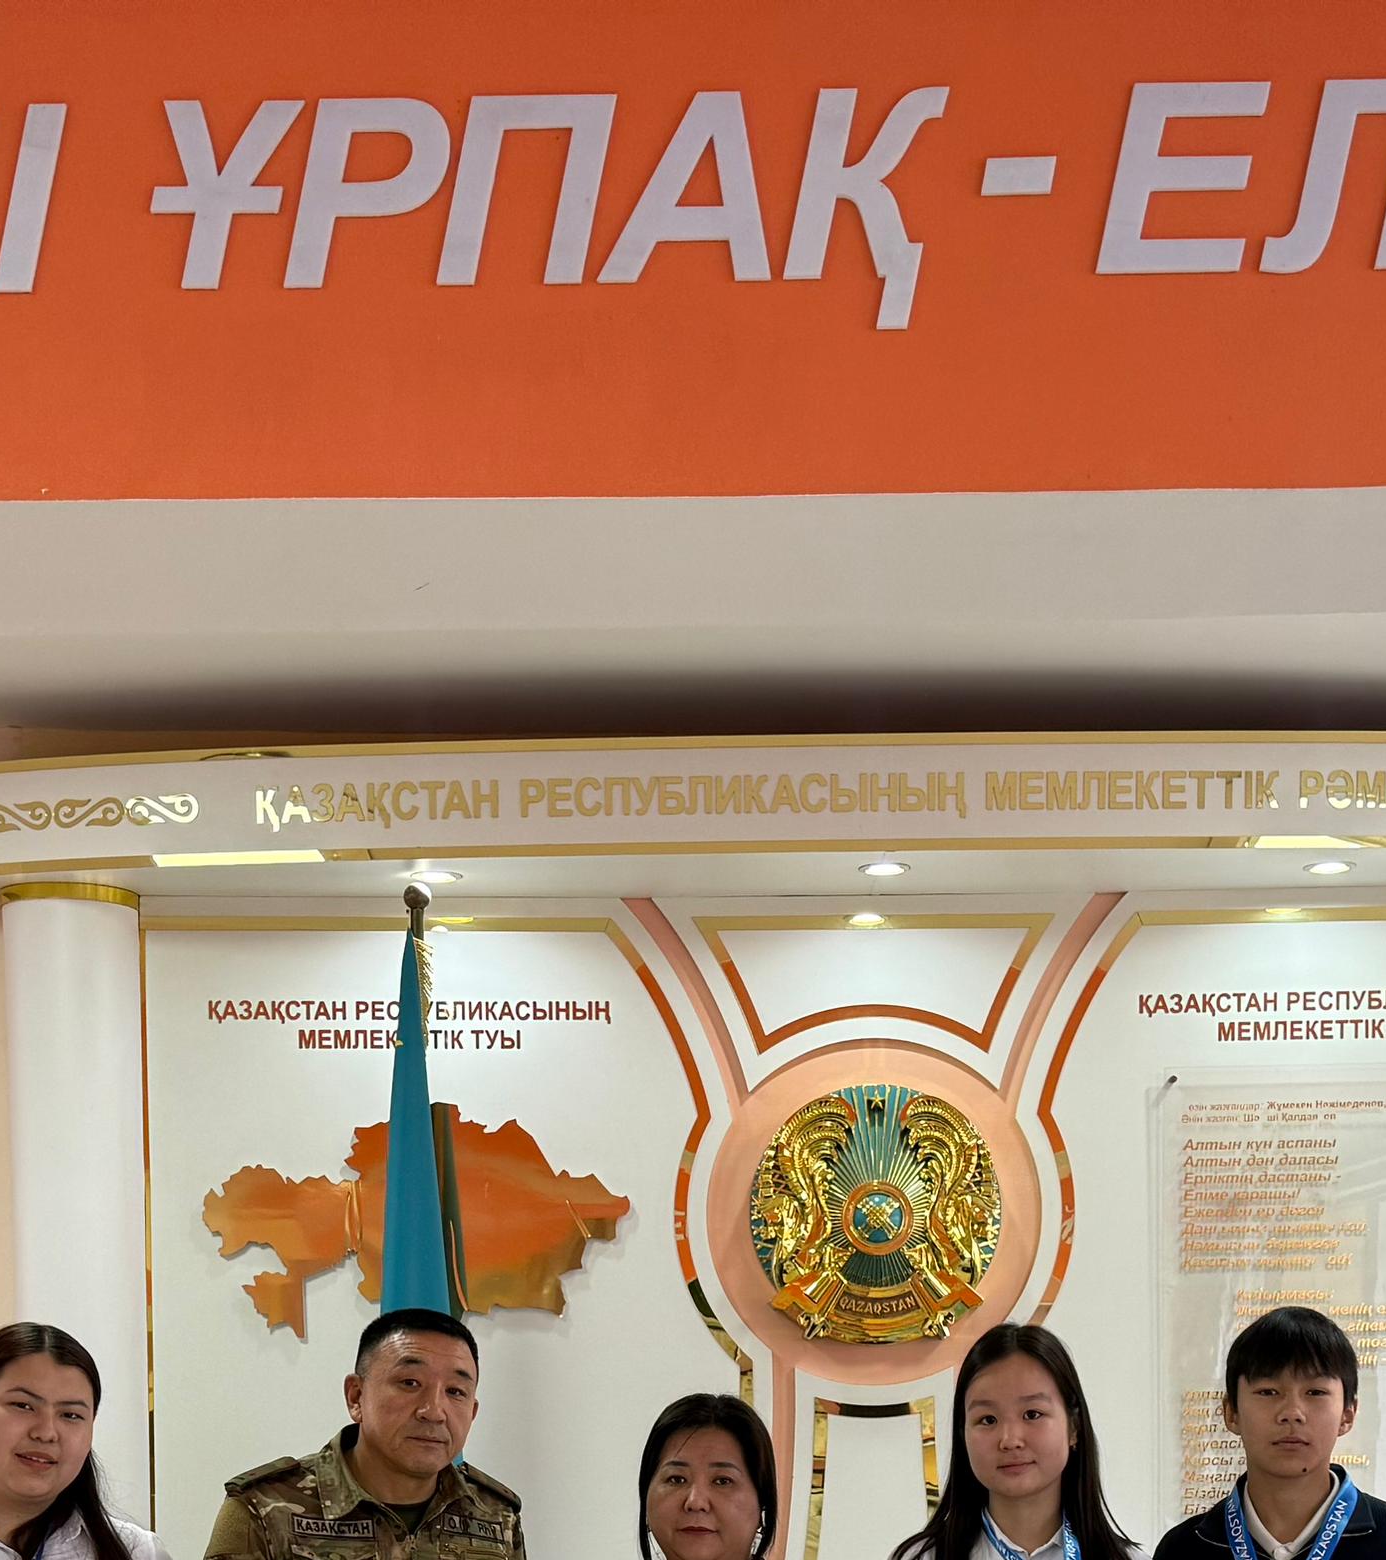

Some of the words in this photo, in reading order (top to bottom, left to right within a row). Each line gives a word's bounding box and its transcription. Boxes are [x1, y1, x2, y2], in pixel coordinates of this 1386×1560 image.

[150, 86, 950, 331] ҰРПАҚ
[255, 780, 499, 832] ҚАЗАҚСТАН
[519, 772, 966, 818] РЕСПУБЛИКАСЫНЫҢ
[985, 770, 1279, 811] МЕМЛЕКЕТТІК
[207, 1000, 347, 1025] ҚАЗАҚСТАН
[355, 1000, 612, 1025] РЕСБЛИКАСЫНЫҢ
[1138, 992, 1278, 1018] ҚАЗАҚСТАН
[298, 1029, 464, 1050] МЕМЛЕКТІК
[473, 1029, 522, 1050] ТУЫ
[1217, 1018, 1384, 1042] МЕМЛЕКЕТТІК
[1183, 1139, 1242, 1151] Алтын
[1277, 1138, 1337, 1150] аспаны
[1183, 1155, 1242, 1168] Алтын
[1279, 1153, 1339, 1167] даласы
[839, 1296, 916, 1315] QAZAQSTAN
